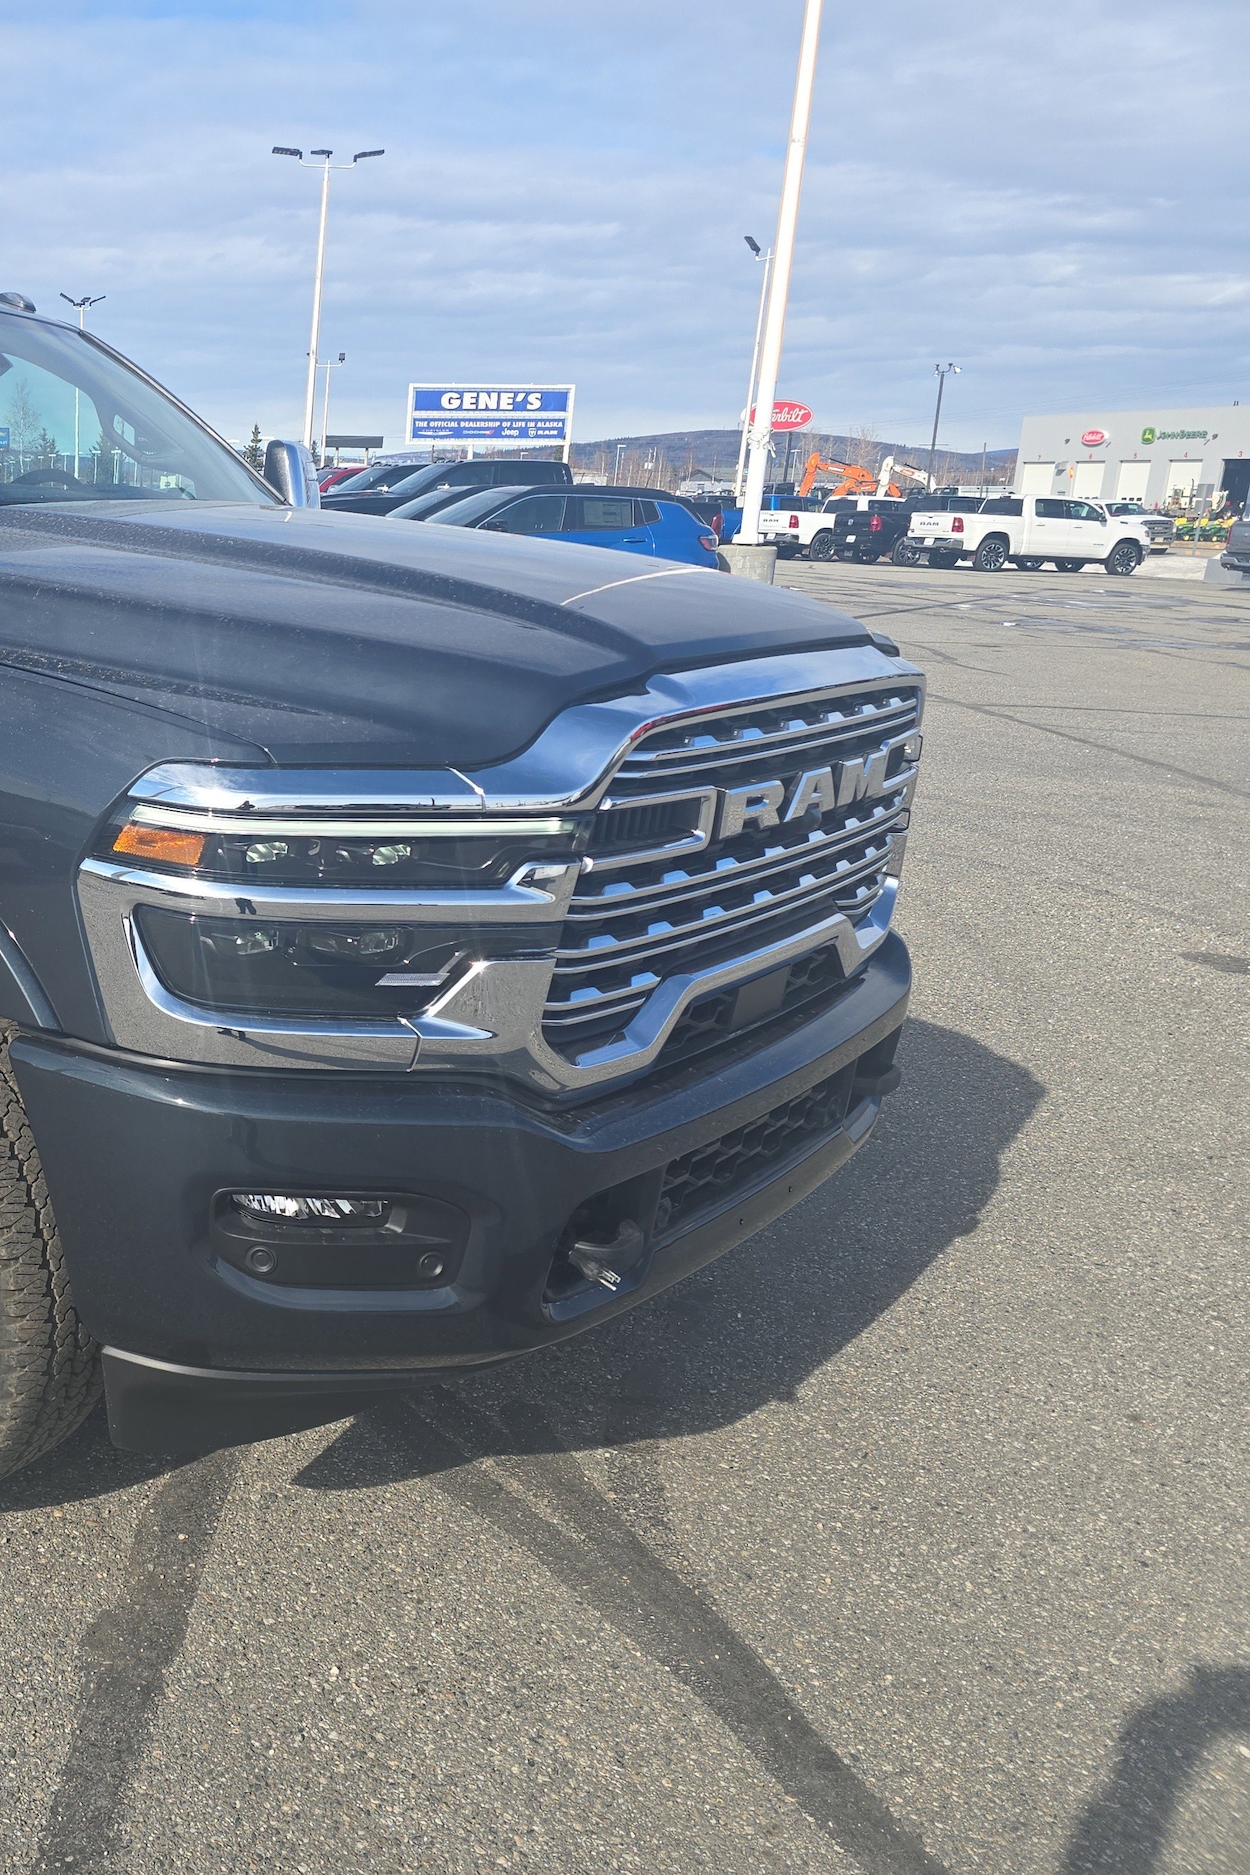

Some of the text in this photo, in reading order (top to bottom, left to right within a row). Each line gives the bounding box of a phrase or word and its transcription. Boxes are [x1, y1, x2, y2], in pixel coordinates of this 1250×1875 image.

[440, 391, 542, 410] GENE'S
[501, 428, 520, 437] Jeep
[718, 749, 887, 841] RAM
